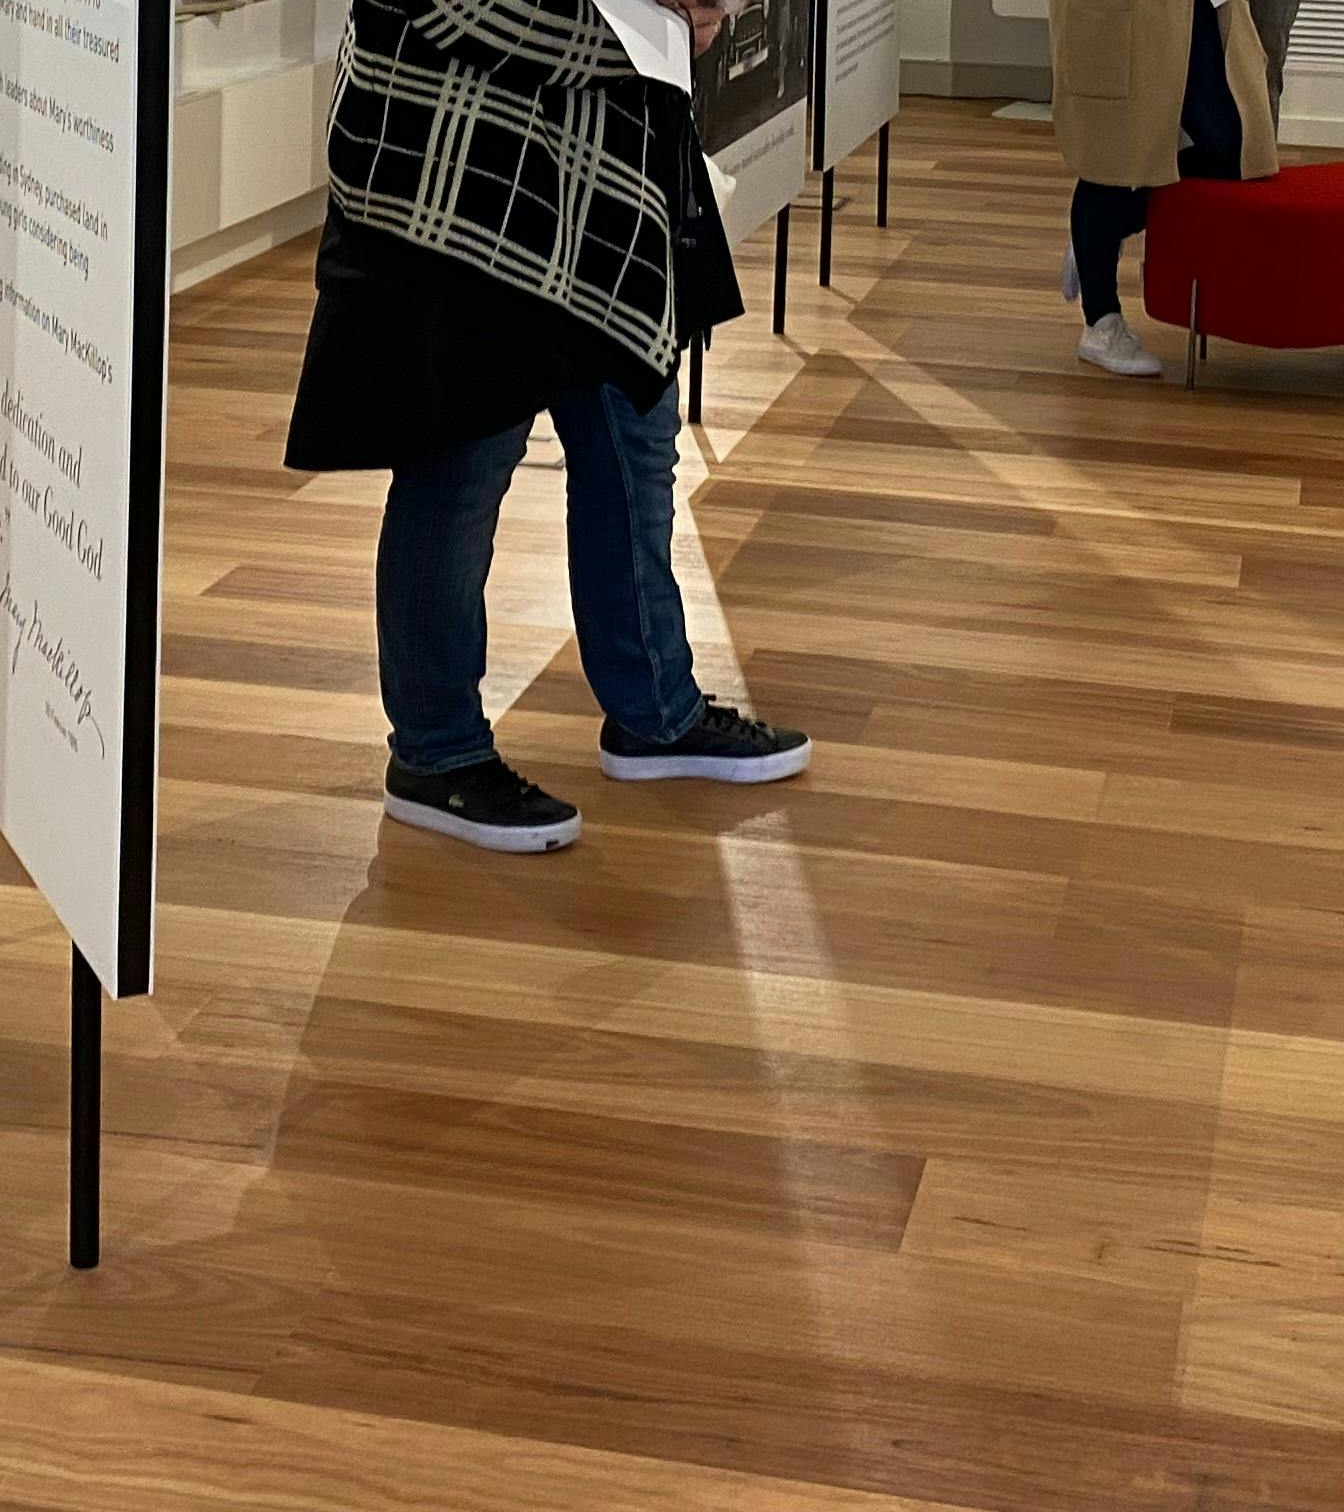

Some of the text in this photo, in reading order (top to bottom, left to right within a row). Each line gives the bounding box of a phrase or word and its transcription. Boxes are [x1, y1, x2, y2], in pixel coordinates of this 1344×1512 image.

[0, 378, 55, 465] dedication
[58, 445, 83, 489] and
[8, 459, 20, 494] to
[21, 478, 42, 515] our
[43, 485, 75, 552] Good
[77, 519, 103, 582] God
